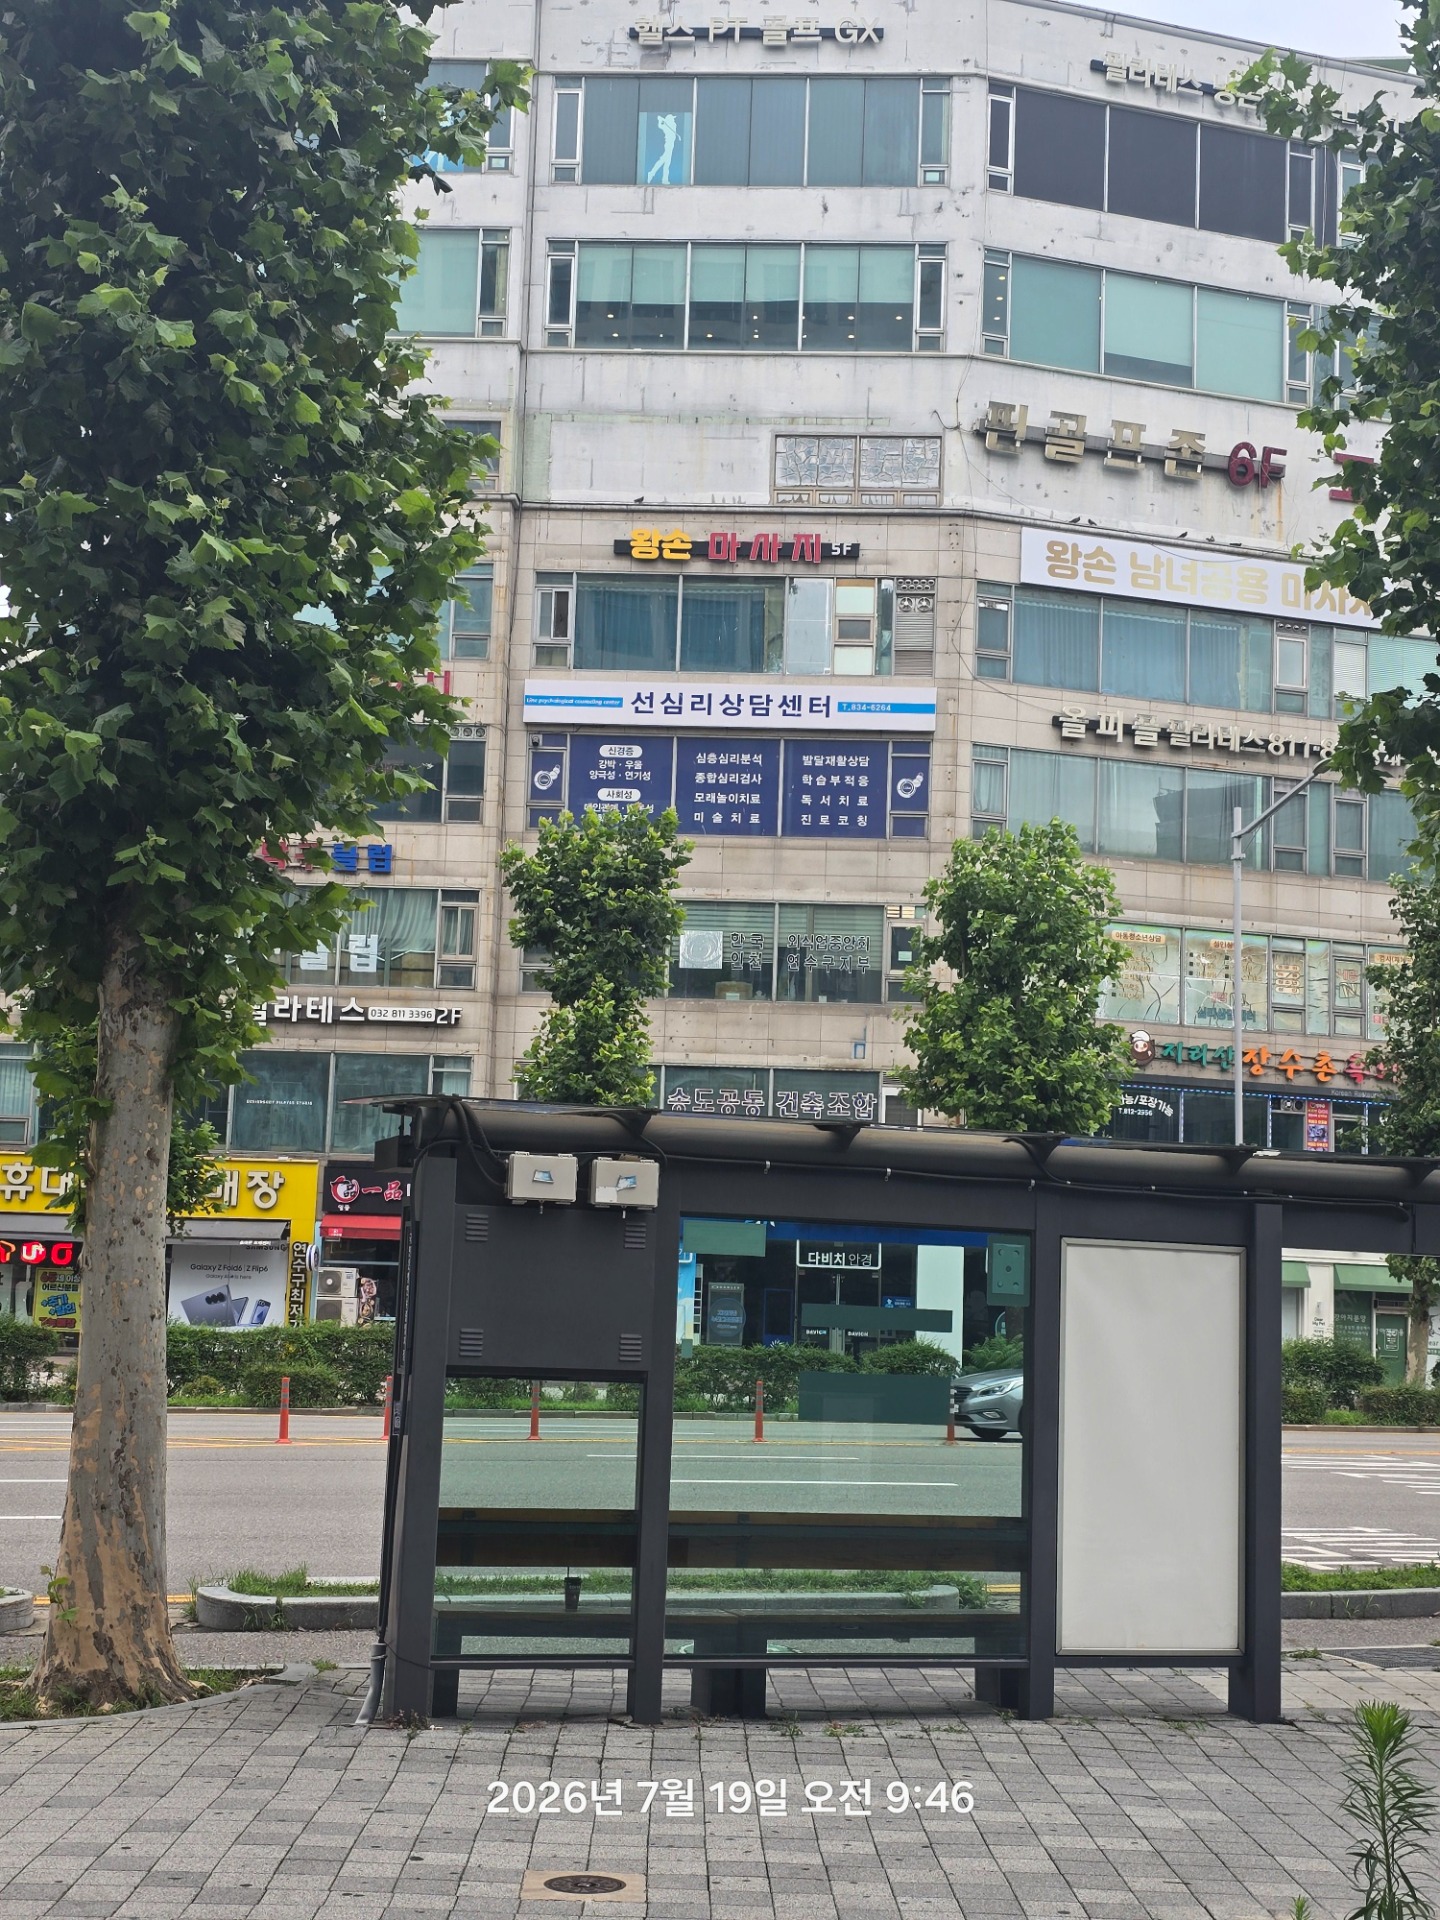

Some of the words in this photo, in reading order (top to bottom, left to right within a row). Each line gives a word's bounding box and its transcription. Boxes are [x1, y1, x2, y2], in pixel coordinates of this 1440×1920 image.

[634, 15, 695, 46] 헬스
[708, 16, 748, 43] PT
[760, 15, 823, 46] 골프
[834, 16, 881, 44] GX
[1103, 51, 1204, 96] 필라테스
[1228, 441, 1288, 489] 6F
[630, 528, 692, 560] 왕손
[708, 532, 822, 563] 마사지
[831, 543, 852, 555] 5F
[1046, 540, 1116, 585] 왕손
[1130, 552, 1269, 605] 남녀공용
[631, 692, 831, 718] 선심리상담센터
[1059, 706, 1161, 747] 올피플
[1167, 719, 1266, 753] 필라테스
[608, 746, 634, 756] 신경증
[598, 759, 616, 769] 강박
[625, 760, 643, 770] 우울
[696, 752, 763, 765] 심층심리분석
[802, 755, 870, 767] 발달재활상담
[589, 770, 616, 780] 양극성
[624, 771, 651, 780] 연기성
[695, 772, 763, 785] 종합심리검사
[802, 774, 870, 787] 학습부적응
[606, 790, 633, 799] 사회성
[694, 792, 761, 805] 모래놀이치료
[801, 795, 869, 807] 독서치료
[693, 812, 761, 824] 미술치료
[801, 814, 868, 827] 진로코칭
[731, 932, 764, 949] 한국
[787, 934, 870, 952] 외식업중앙회
[731, 951, 762, 971] 인천
[787, 953, 871, 974] 연수구지부
[370, 1008, 389, 1018] 032
[392, 1009, 406, 1018] 811
[408, 1009, 433, 1019] 3396
[436, 1007, 463, 1025] 2F
[1163, 1042, 1235, 1072] 지리산
[1242, 1046, 1338, 1082] 장수촌
[667, 1088, 765, 1116] 송도공동
[775, 1091, 878, 1120] 건축조합
[808, 1251, 845, 1266] 다비치
[848, 1253, 873, 1267] 안경
[190, 1263, 216, 1273] Galaxy
[252, 1265, 269, 1273] Flip6
